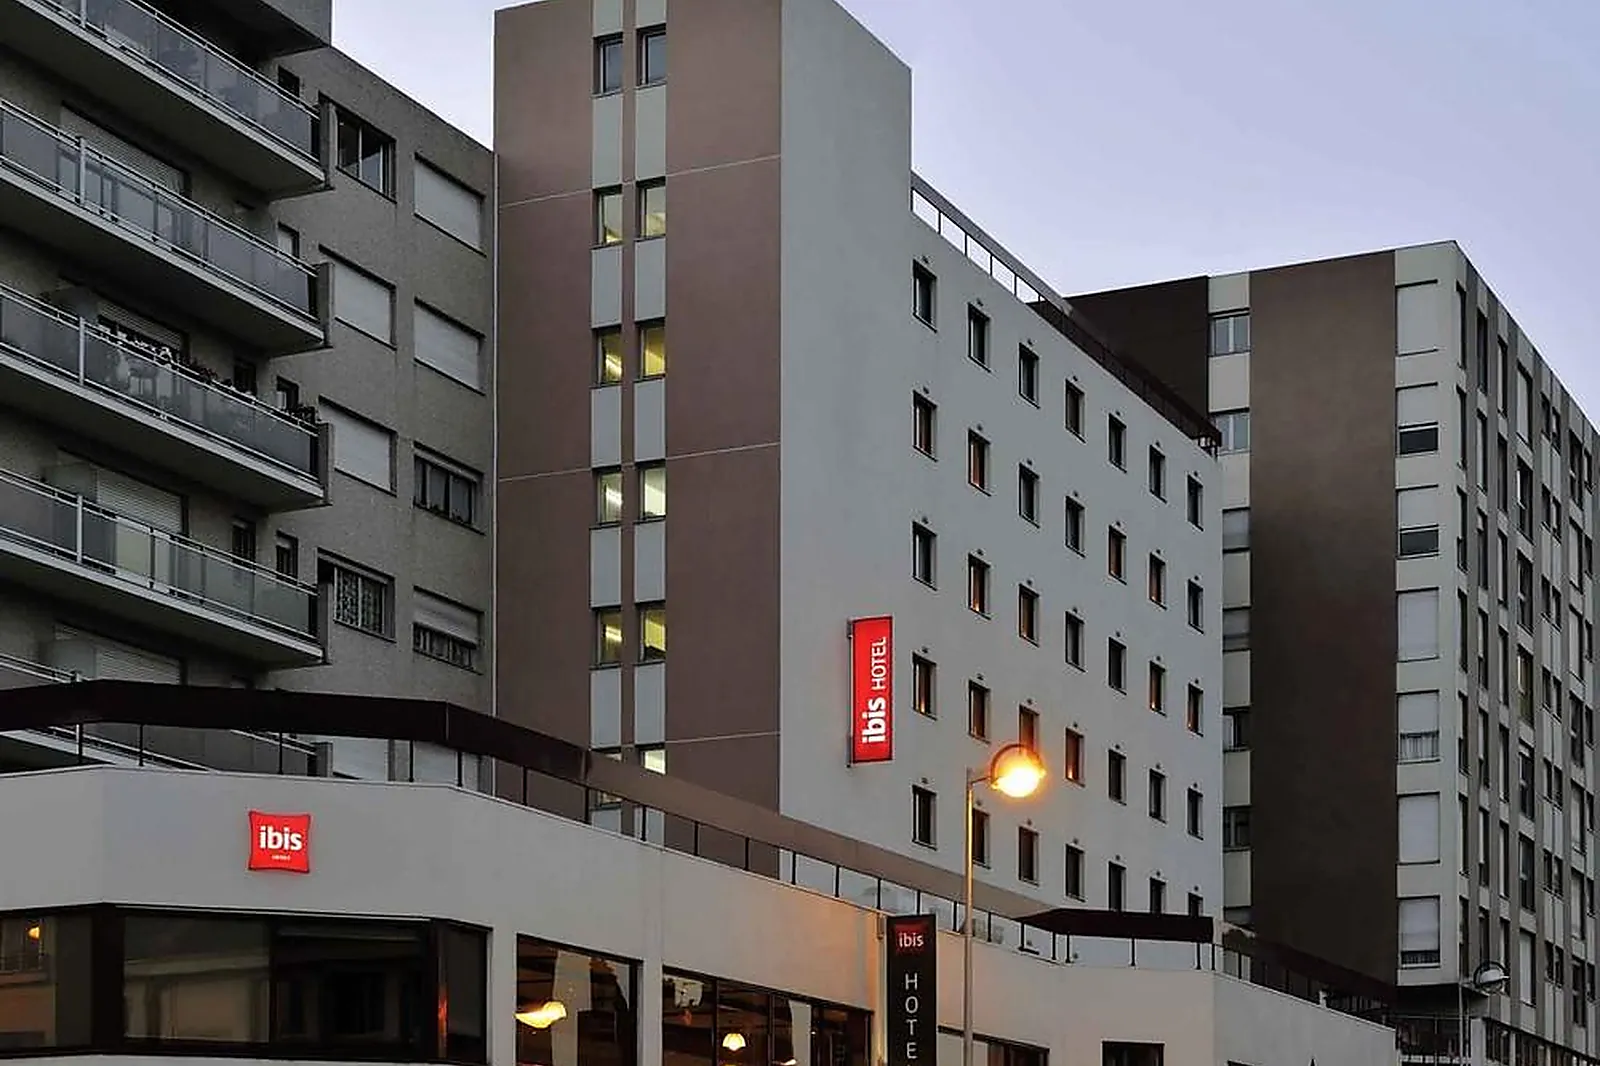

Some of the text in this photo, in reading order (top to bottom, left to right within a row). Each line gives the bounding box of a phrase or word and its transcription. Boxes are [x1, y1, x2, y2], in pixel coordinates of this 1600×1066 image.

[861, 636, 887, 743] ibis HOTEL
[260, 825, 303, 851] ibis
[899, 932, 924, 948] ibis
[904, 972, 919, 1066] HOTE
